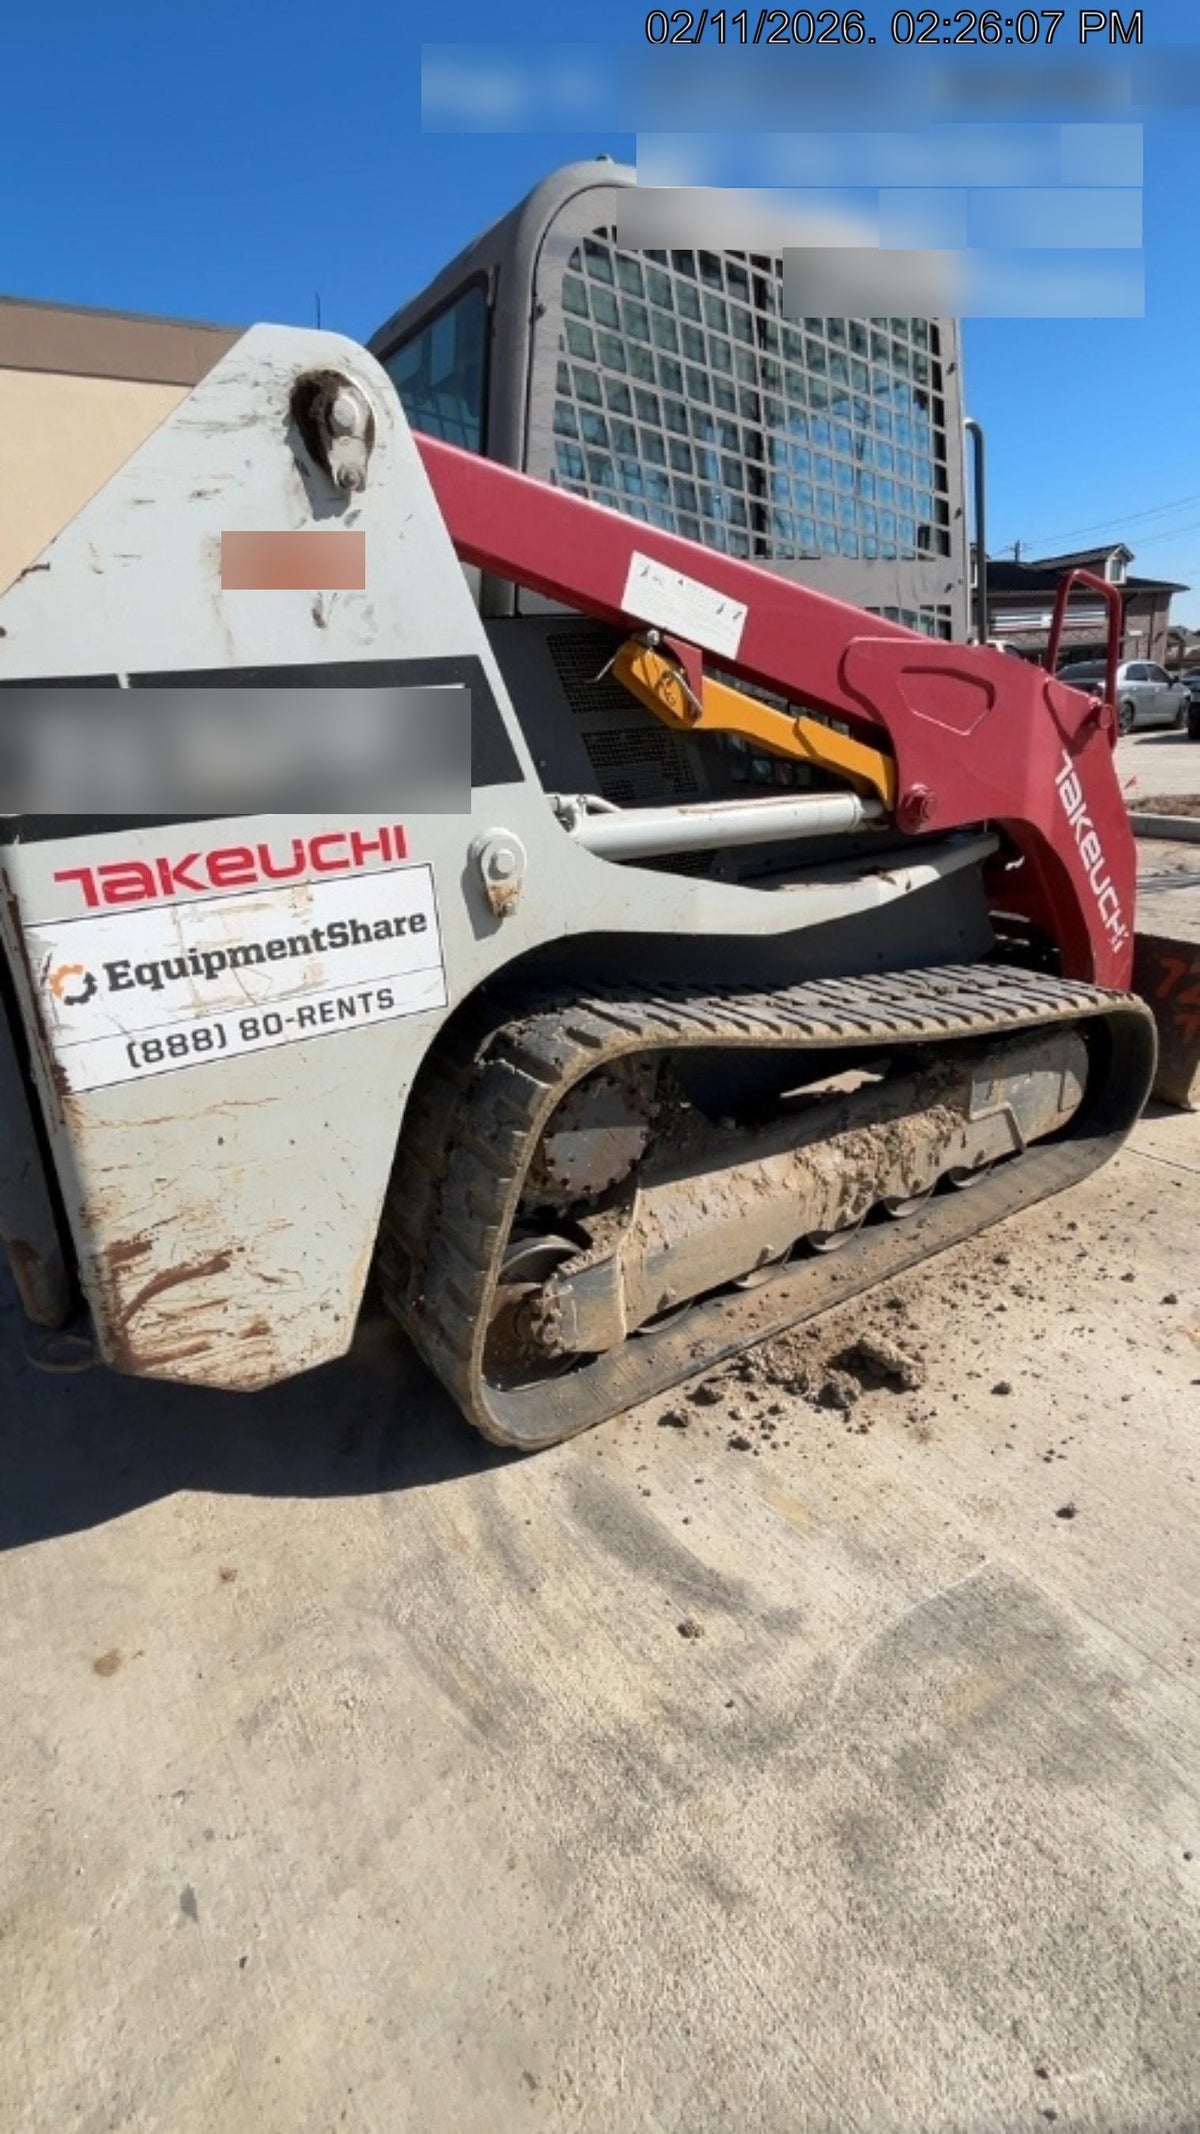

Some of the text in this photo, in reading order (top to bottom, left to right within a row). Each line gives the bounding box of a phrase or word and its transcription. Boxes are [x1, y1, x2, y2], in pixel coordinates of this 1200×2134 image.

[102, 911, 428, 992] EquipmentShare
[126, 988, 395, 1069] (888) 80-RENTS
